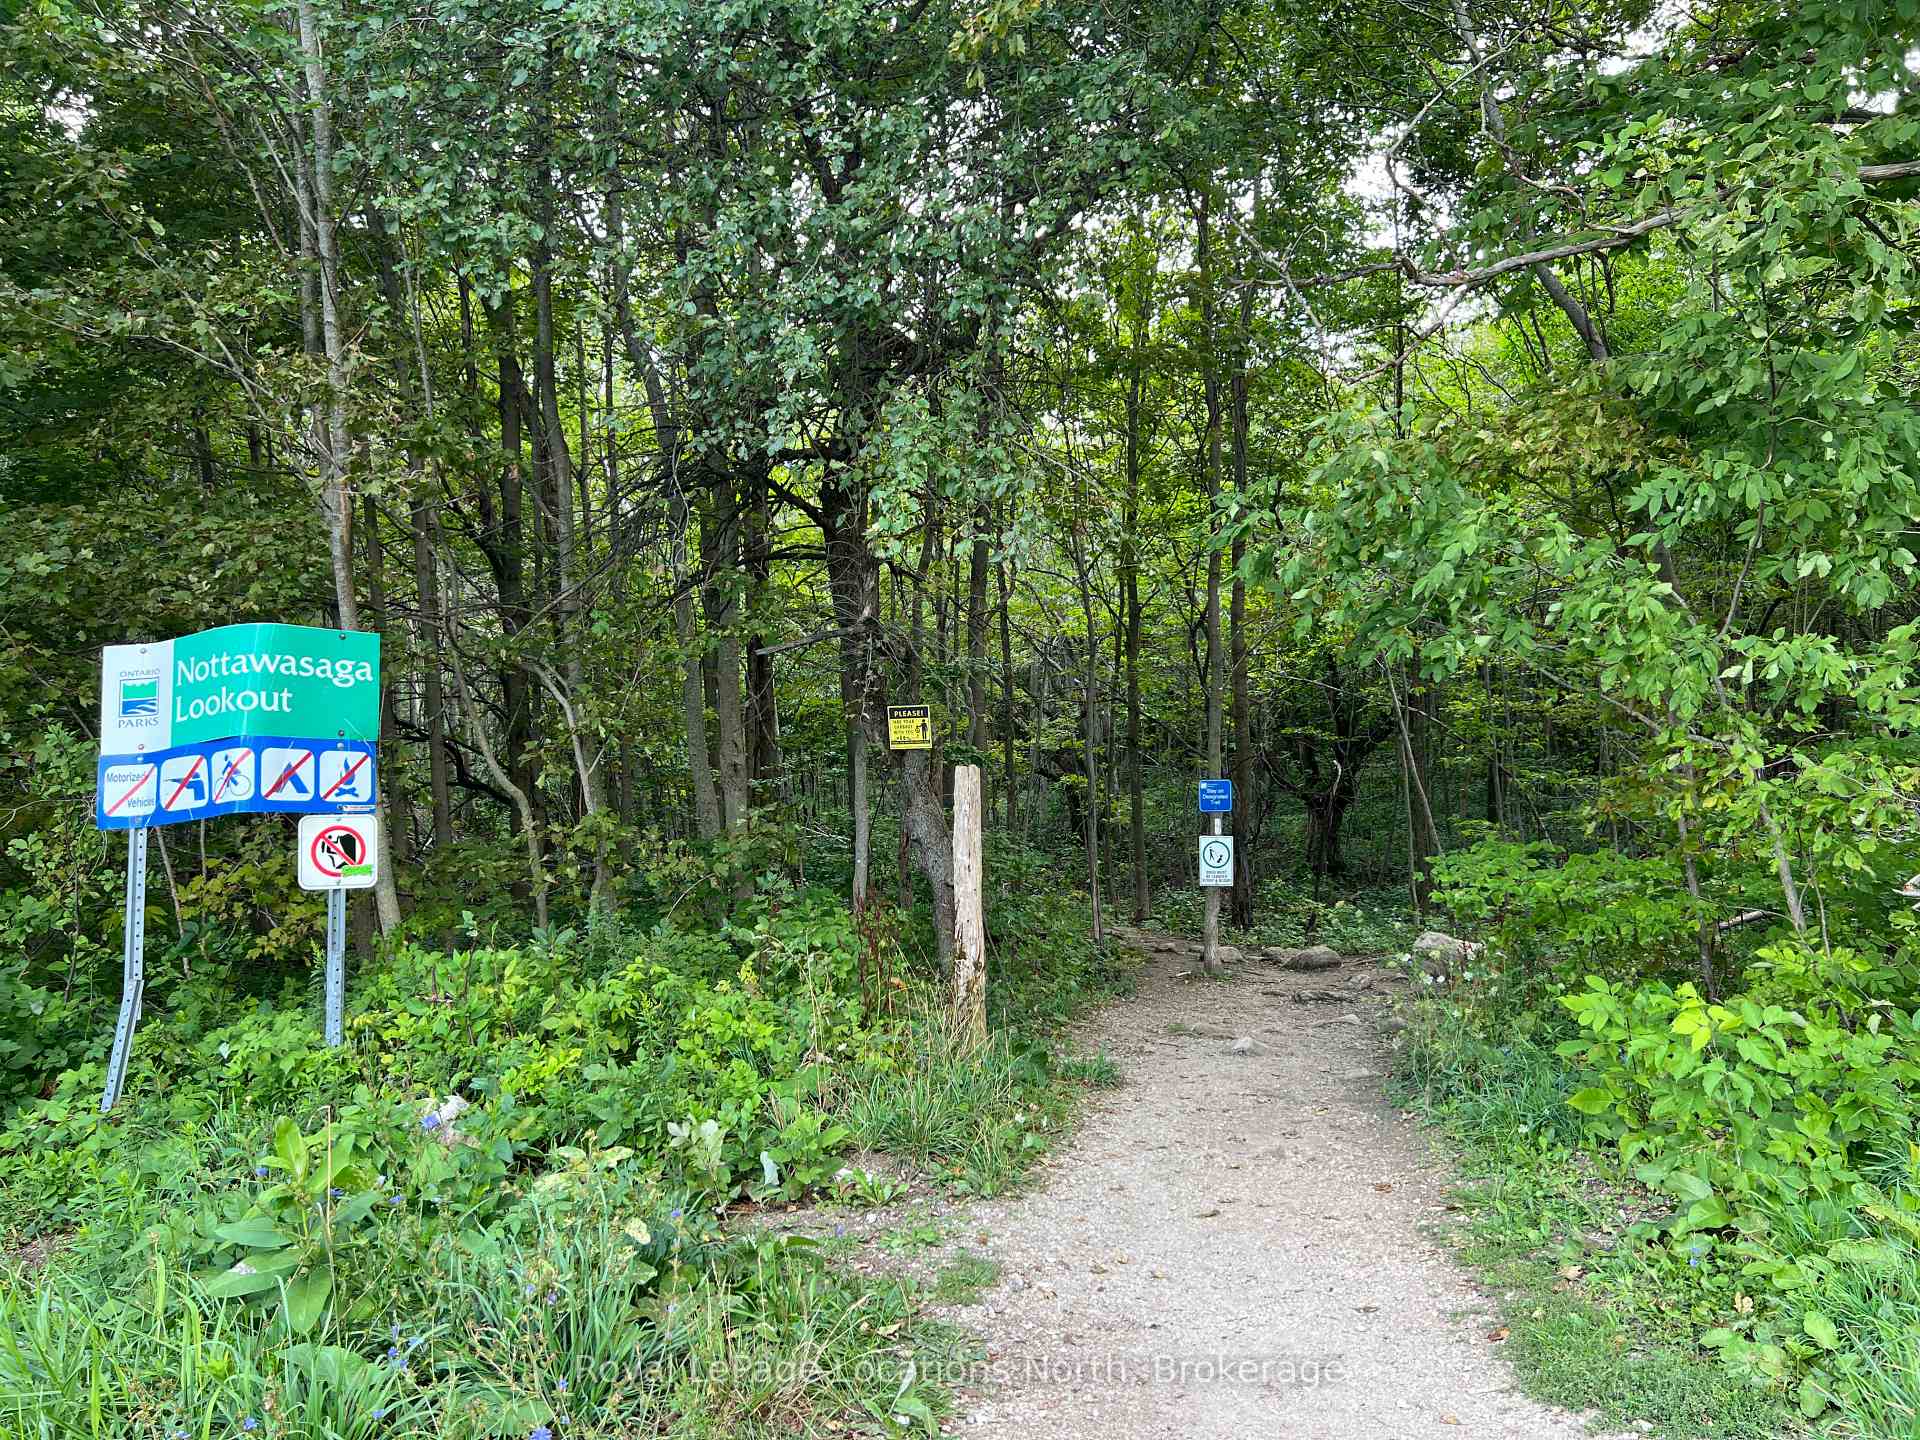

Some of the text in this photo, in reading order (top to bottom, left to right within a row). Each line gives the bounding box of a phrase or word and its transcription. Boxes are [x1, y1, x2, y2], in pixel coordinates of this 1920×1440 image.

[120, 668, 160, 678] ONTARIO
[176, 652, 374, 688] Nottawasaga
[175, 686, 293, 723] Lookout
[894, 710, 924, 718] PLEASE!
[118, 717, 160, 729] PARKS
[106, 771, 147, 783] Motorized
